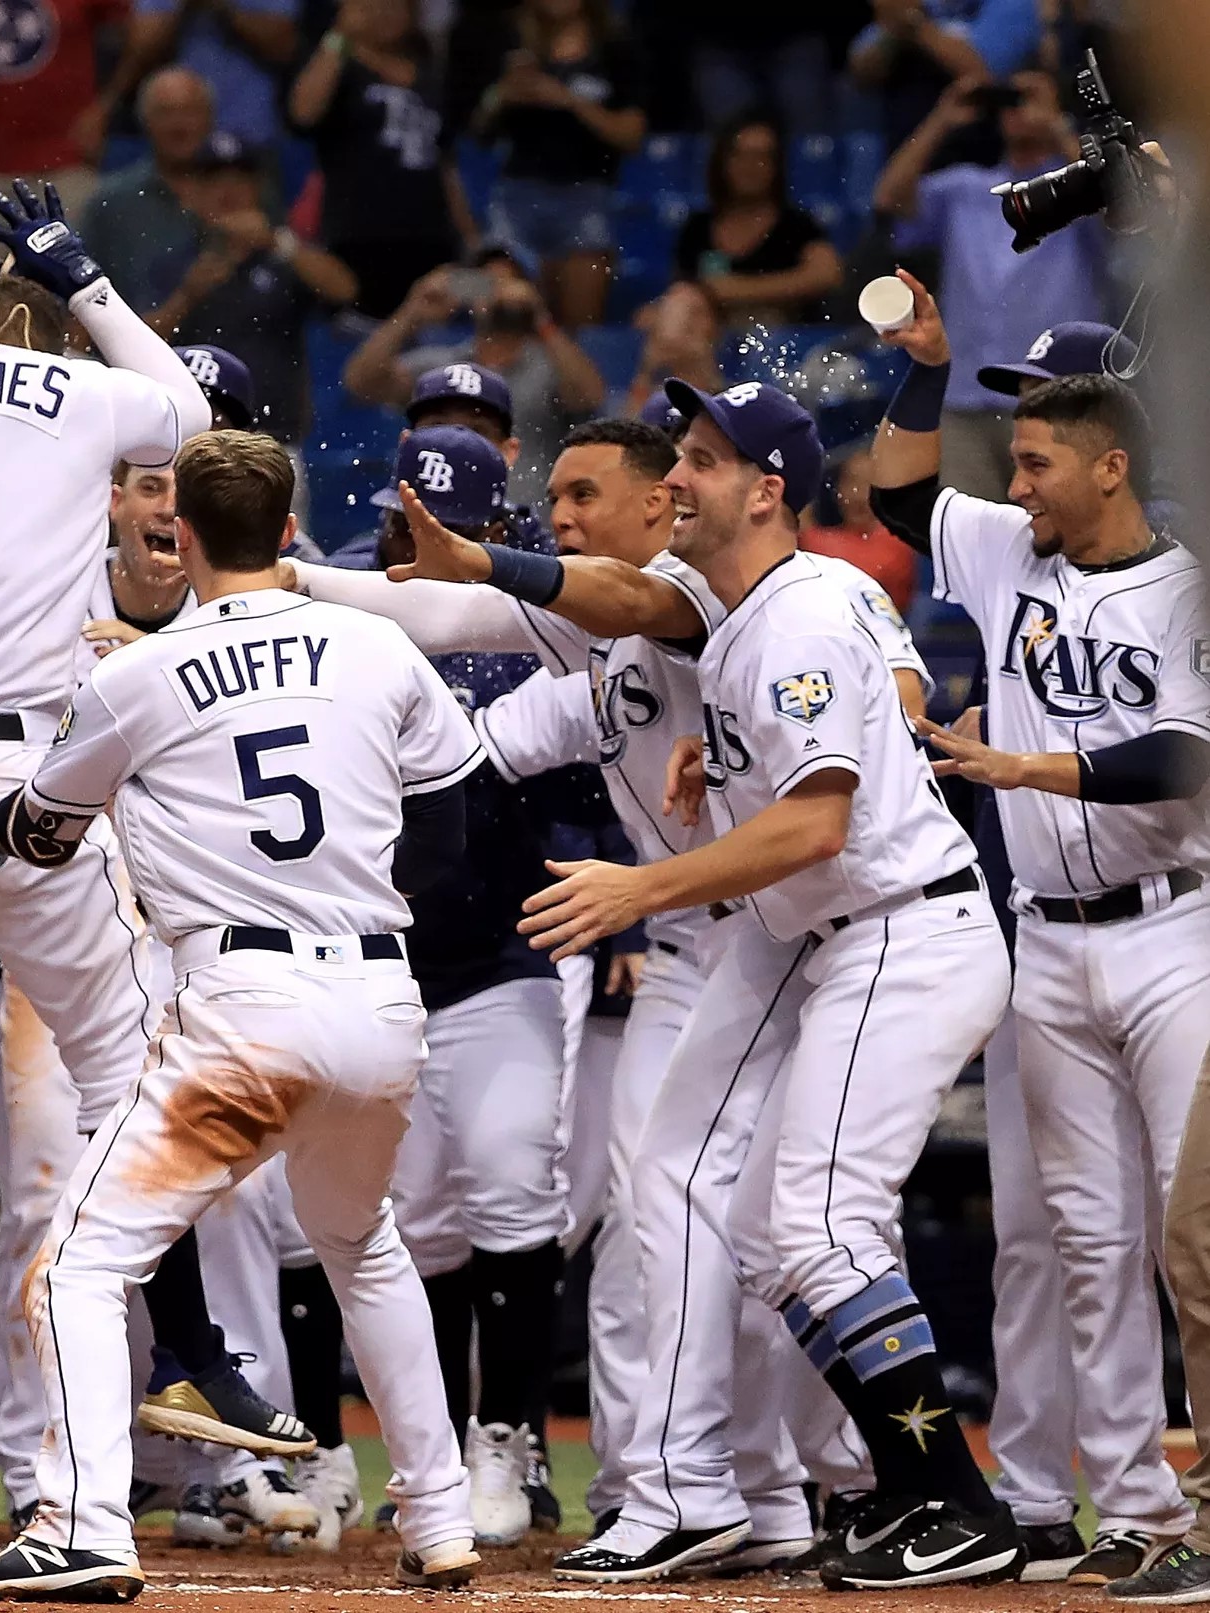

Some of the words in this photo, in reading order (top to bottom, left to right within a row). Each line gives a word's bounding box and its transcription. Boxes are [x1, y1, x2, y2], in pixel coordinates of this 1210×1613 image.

[184, 349, 220, 386] TB
[444, 364, 482, 396] TB
[417, 450, 455, 493] TB
[176, 635, 329, 713] DUFFY
[233, 724, 326, 862] 5
